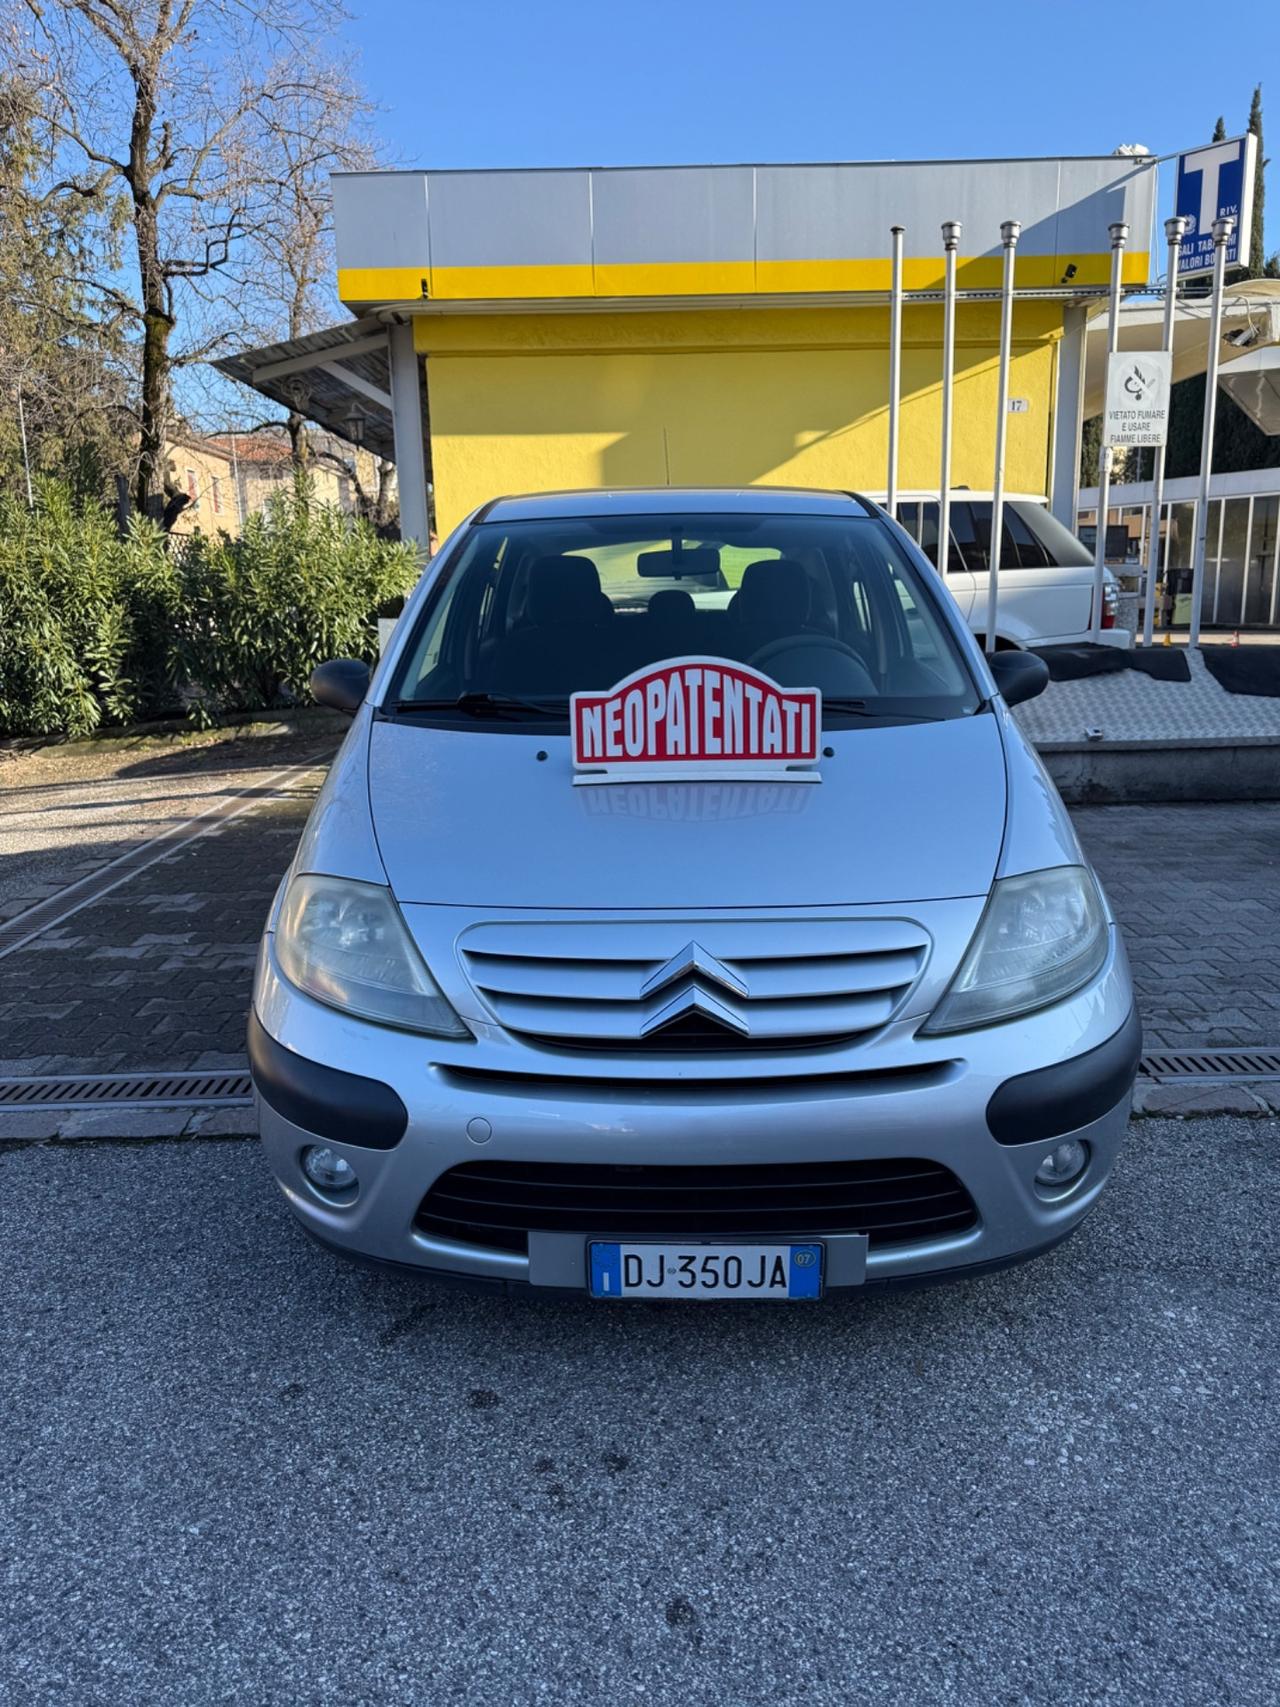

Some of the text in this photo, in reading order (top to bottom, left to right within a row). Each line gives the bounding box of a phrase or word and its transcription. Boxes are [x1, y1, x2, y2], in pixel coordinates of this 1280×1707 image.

[1184, 140, 1240, 235] T
[1220, 204, 1238, 216] RIV.
[1012, 400, 1022, 411] 17
[1109, 410, 1166, 420] VIETATO FUMARE
[1121, 422, 1151, 431] E USARE
[1110, 434, 1161, 443] FIAMME LIBERE
[582, 668, 811, 758] NEOPATENTATI
